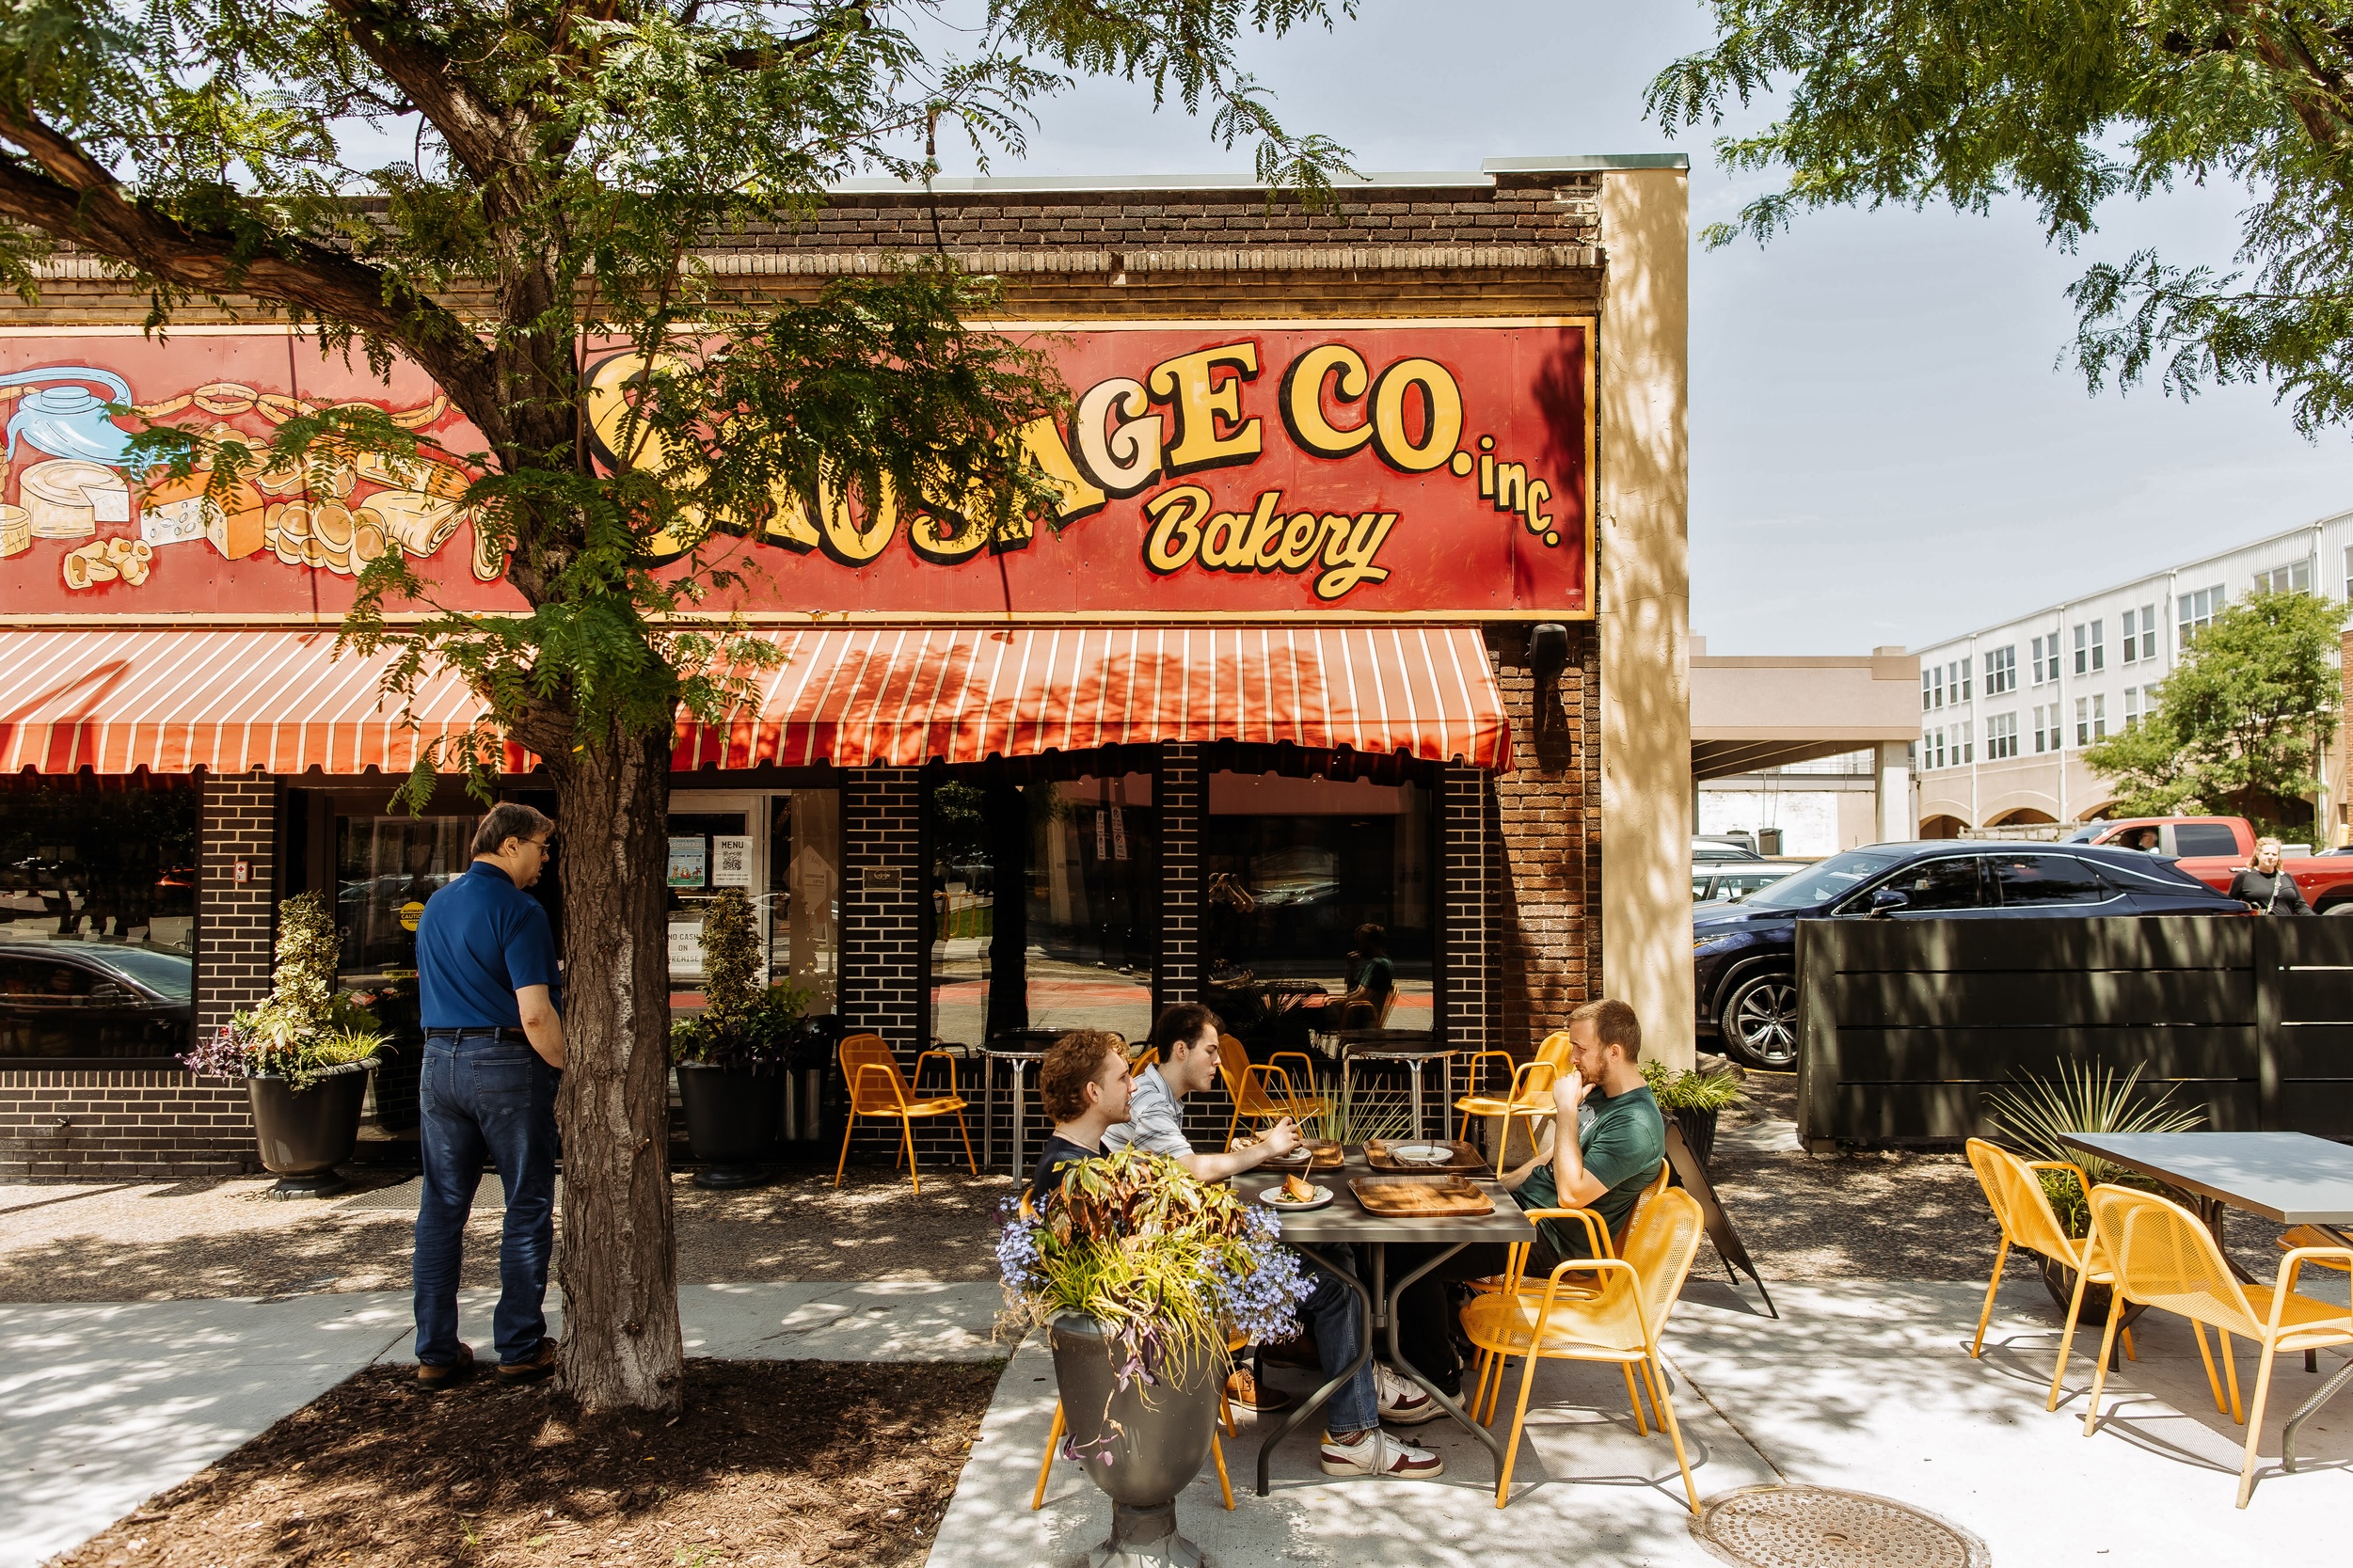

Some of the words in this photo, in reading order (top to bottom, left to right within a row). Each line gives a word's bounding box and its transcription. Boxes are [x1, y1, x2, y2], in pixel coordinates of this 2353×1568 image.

[1278, 343, 1474, 476] CO.
[1475, 434, 1562, 548] inc.
[1141, 483, 1399, 602] Bakery
[722, 841, 744, 849] MENU
